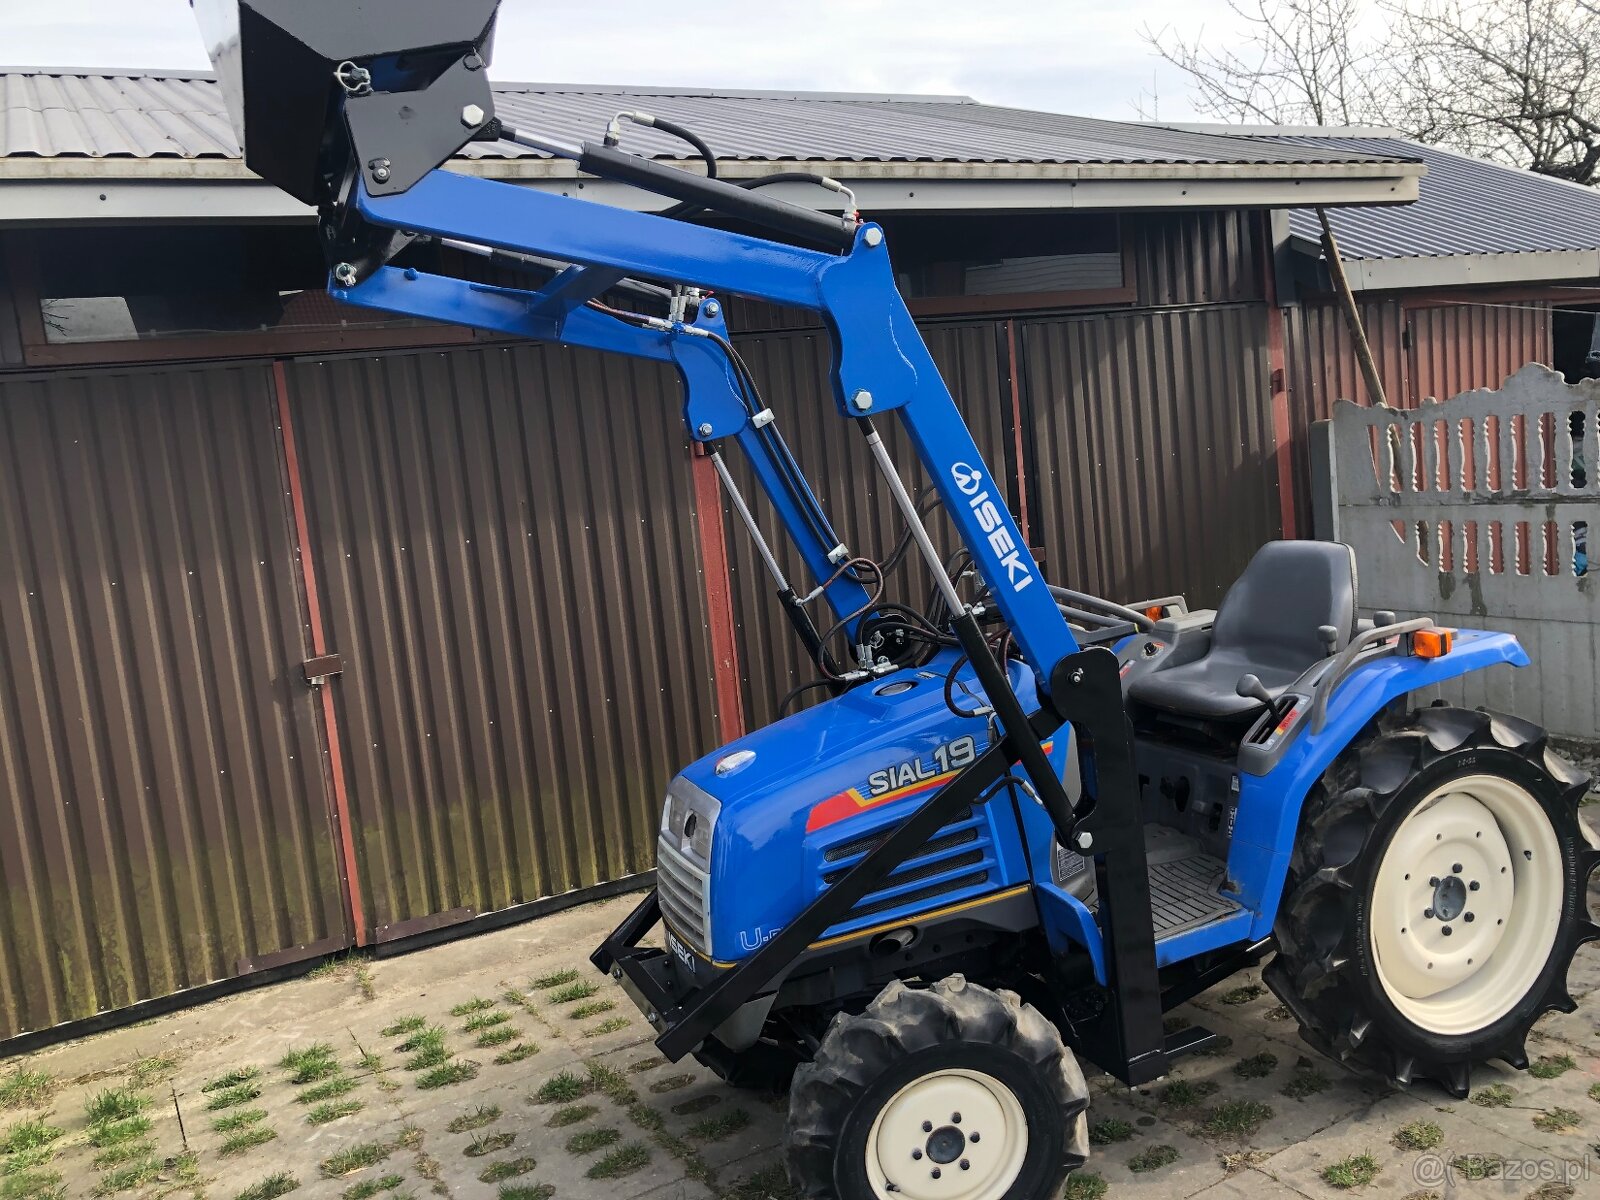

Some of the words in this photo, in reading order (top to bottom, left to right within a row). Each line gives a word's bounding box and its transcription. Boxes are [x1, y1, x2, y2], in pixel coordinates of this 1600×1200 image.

[969, 491, 1034, 592] ISEKI
[868, 757, 936, 796] SIAL
[933, 735, 976, 772] 19
[668, 931, 696, 974] ISEKI
